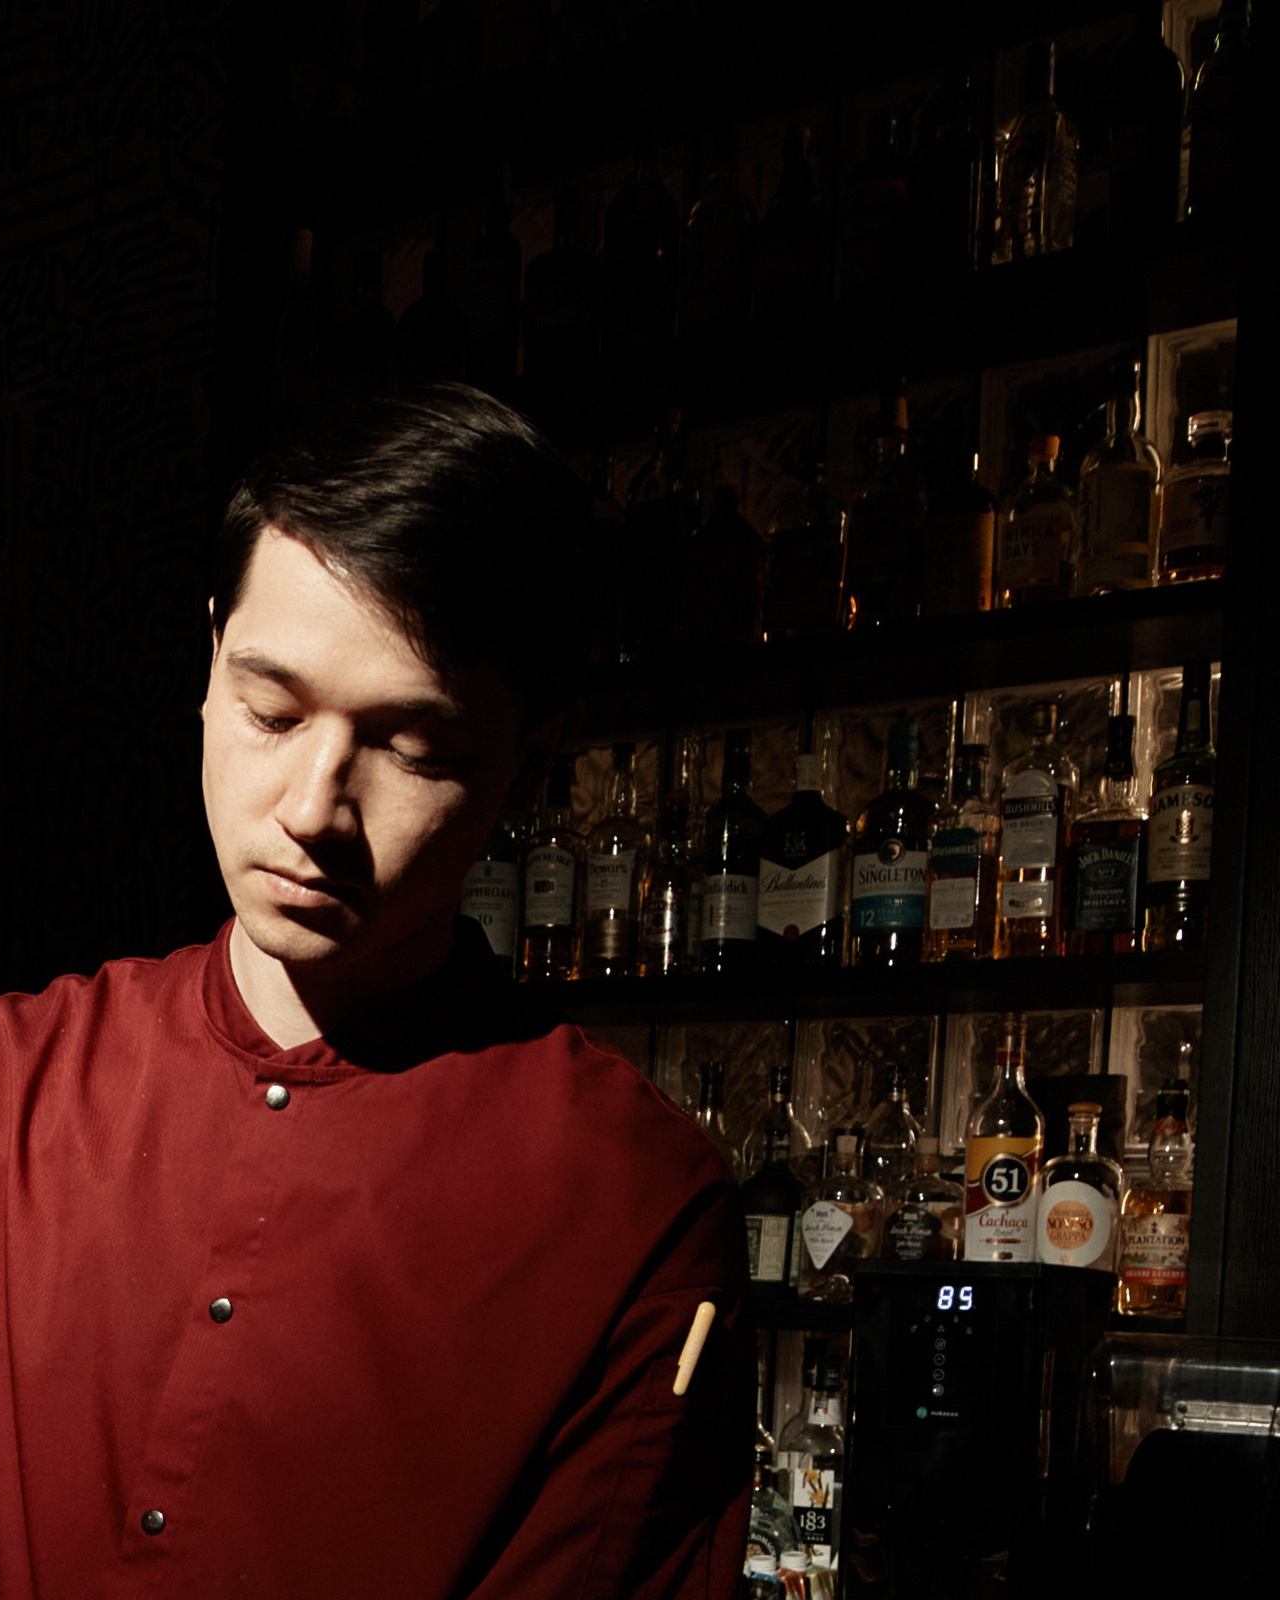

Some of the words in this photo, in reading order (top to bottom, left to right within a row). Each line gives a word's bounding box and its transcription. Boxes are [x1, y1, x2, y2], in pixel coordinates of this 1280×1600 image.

[1006, 522, 1053, 542] NIKKA
[1005, 543, 1039, 560] DAYS
[1004, 799, 1057, 815] BUSHMILLS
[1078, 851, 1100, 869] JACK
[859, 868, 926, 885] SINGLETON
[860, 909, 876, 927] 12
[990, 1167, 1021, 1193] 51
[979, 1213, 1028, 1231] Cachaça
[1128, 1235, 1185, 1246] PLANTATION
